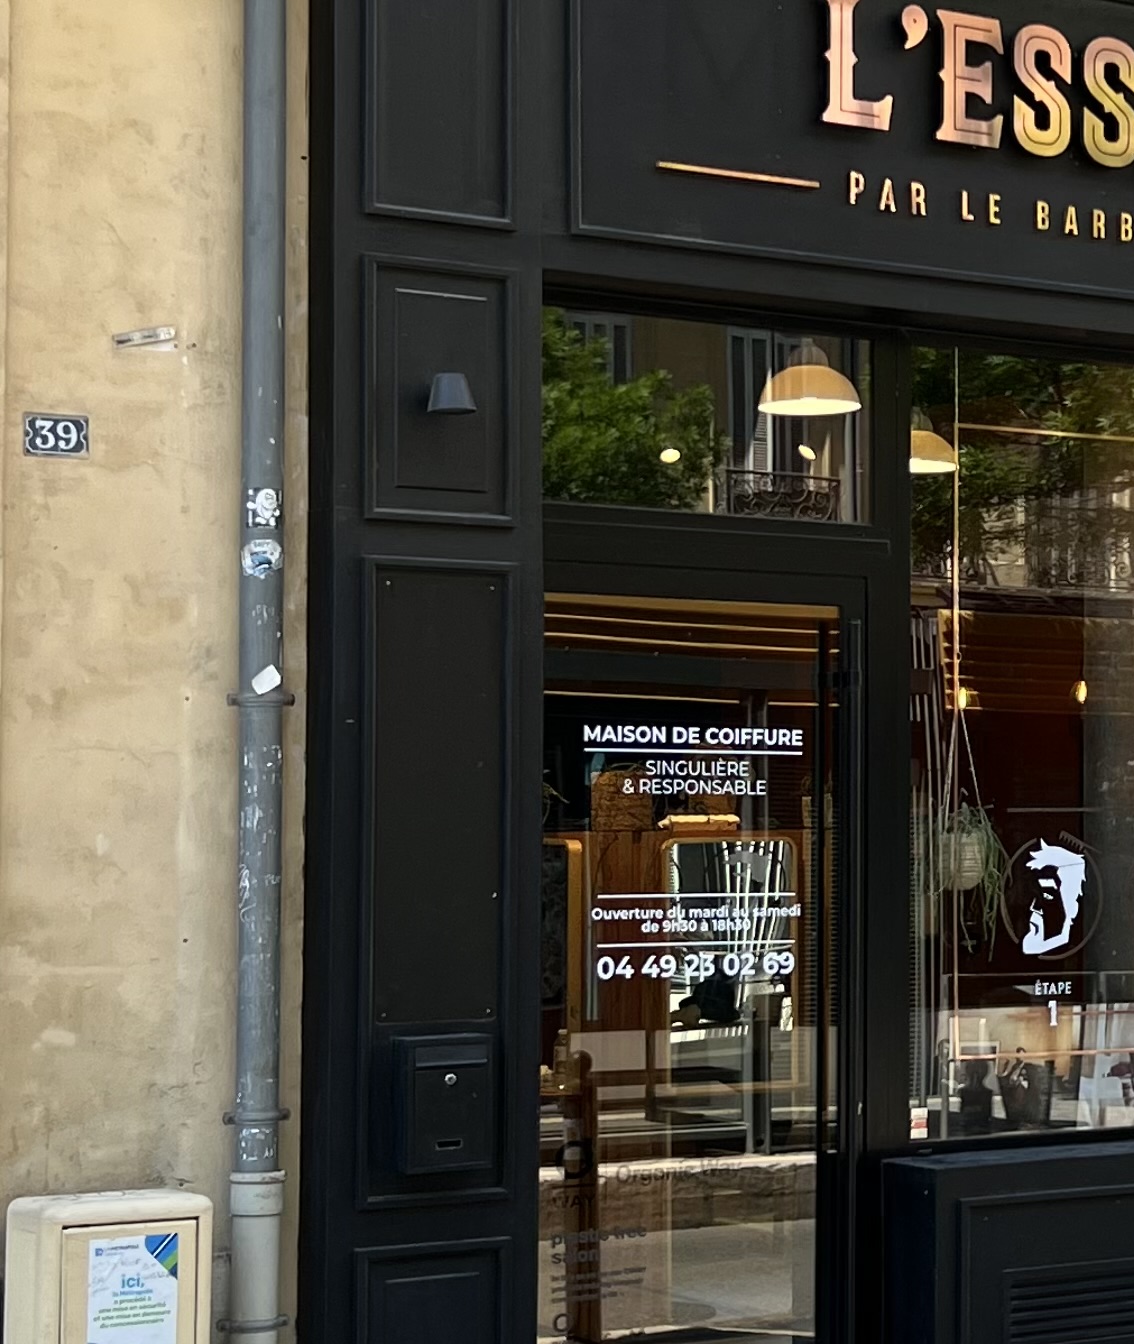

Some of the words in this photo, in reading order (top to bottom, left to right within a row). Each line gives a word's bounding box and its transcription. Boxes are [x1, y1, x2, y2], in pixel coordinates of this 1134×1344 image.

[849, 171, 927, 216] PAR
[961, 190, 1001, 224] LE
[35, 420, 78, 449] 39
[583, 725, 666, 744] MAISON
[672, 727, 701, 744] DE
[705, 727, 803, 746] COIFFURE
[645, 757, 750, 777] SINGULIÈRE
[622, 778, 635, 794] &
[639, 779, 767, 795] RESPONSABLE
[591, 908, 664, 920] Ouverture
[667, 906, 686, 919] du
[689, 905, 729, 919] mardi
[732, 907, 749, 918] au
[753, 904, 801, 917] samedi
[641, 920, 660, 933] de
[662, 919, 698, 933] 9h30
[700, 918, 709, 932] à
[597, 956, 635, 980] 04
[641, 954, 677, 978] 49
[684, 952, 716, 977] 23
[723, 952, 756, 976] 02
[762, 951, 795, 975] 69
[1035, 980, 1072, 996] ÉTAPE
[1048, 1000, 1058, 1026] 1
